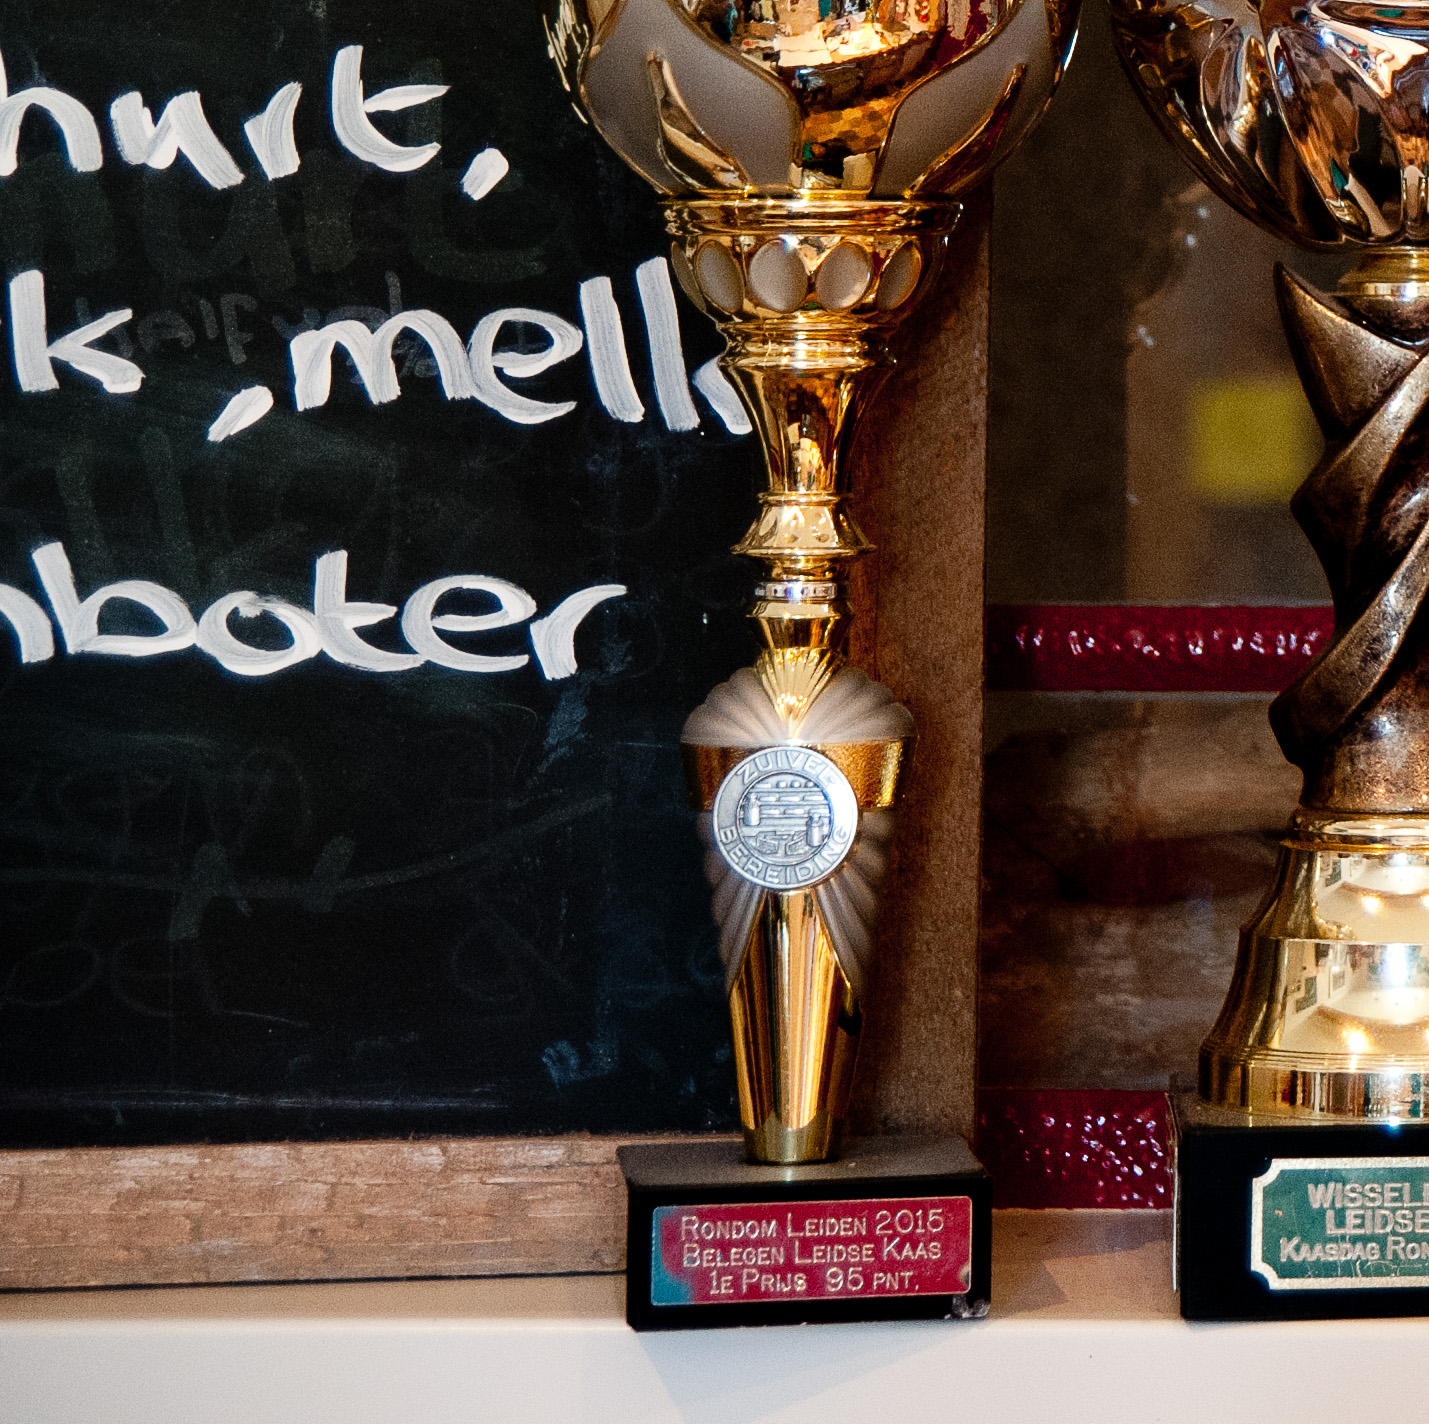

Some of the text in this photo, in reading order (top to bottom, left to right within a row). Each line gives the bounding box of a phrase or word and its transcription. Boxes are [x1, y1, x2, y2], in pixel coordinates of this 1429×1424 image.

[719, 826, 848, 884] BEREIDING
[875, 1208, 945, 1236] 2015
[825, 1266, 864, 1292] 95
